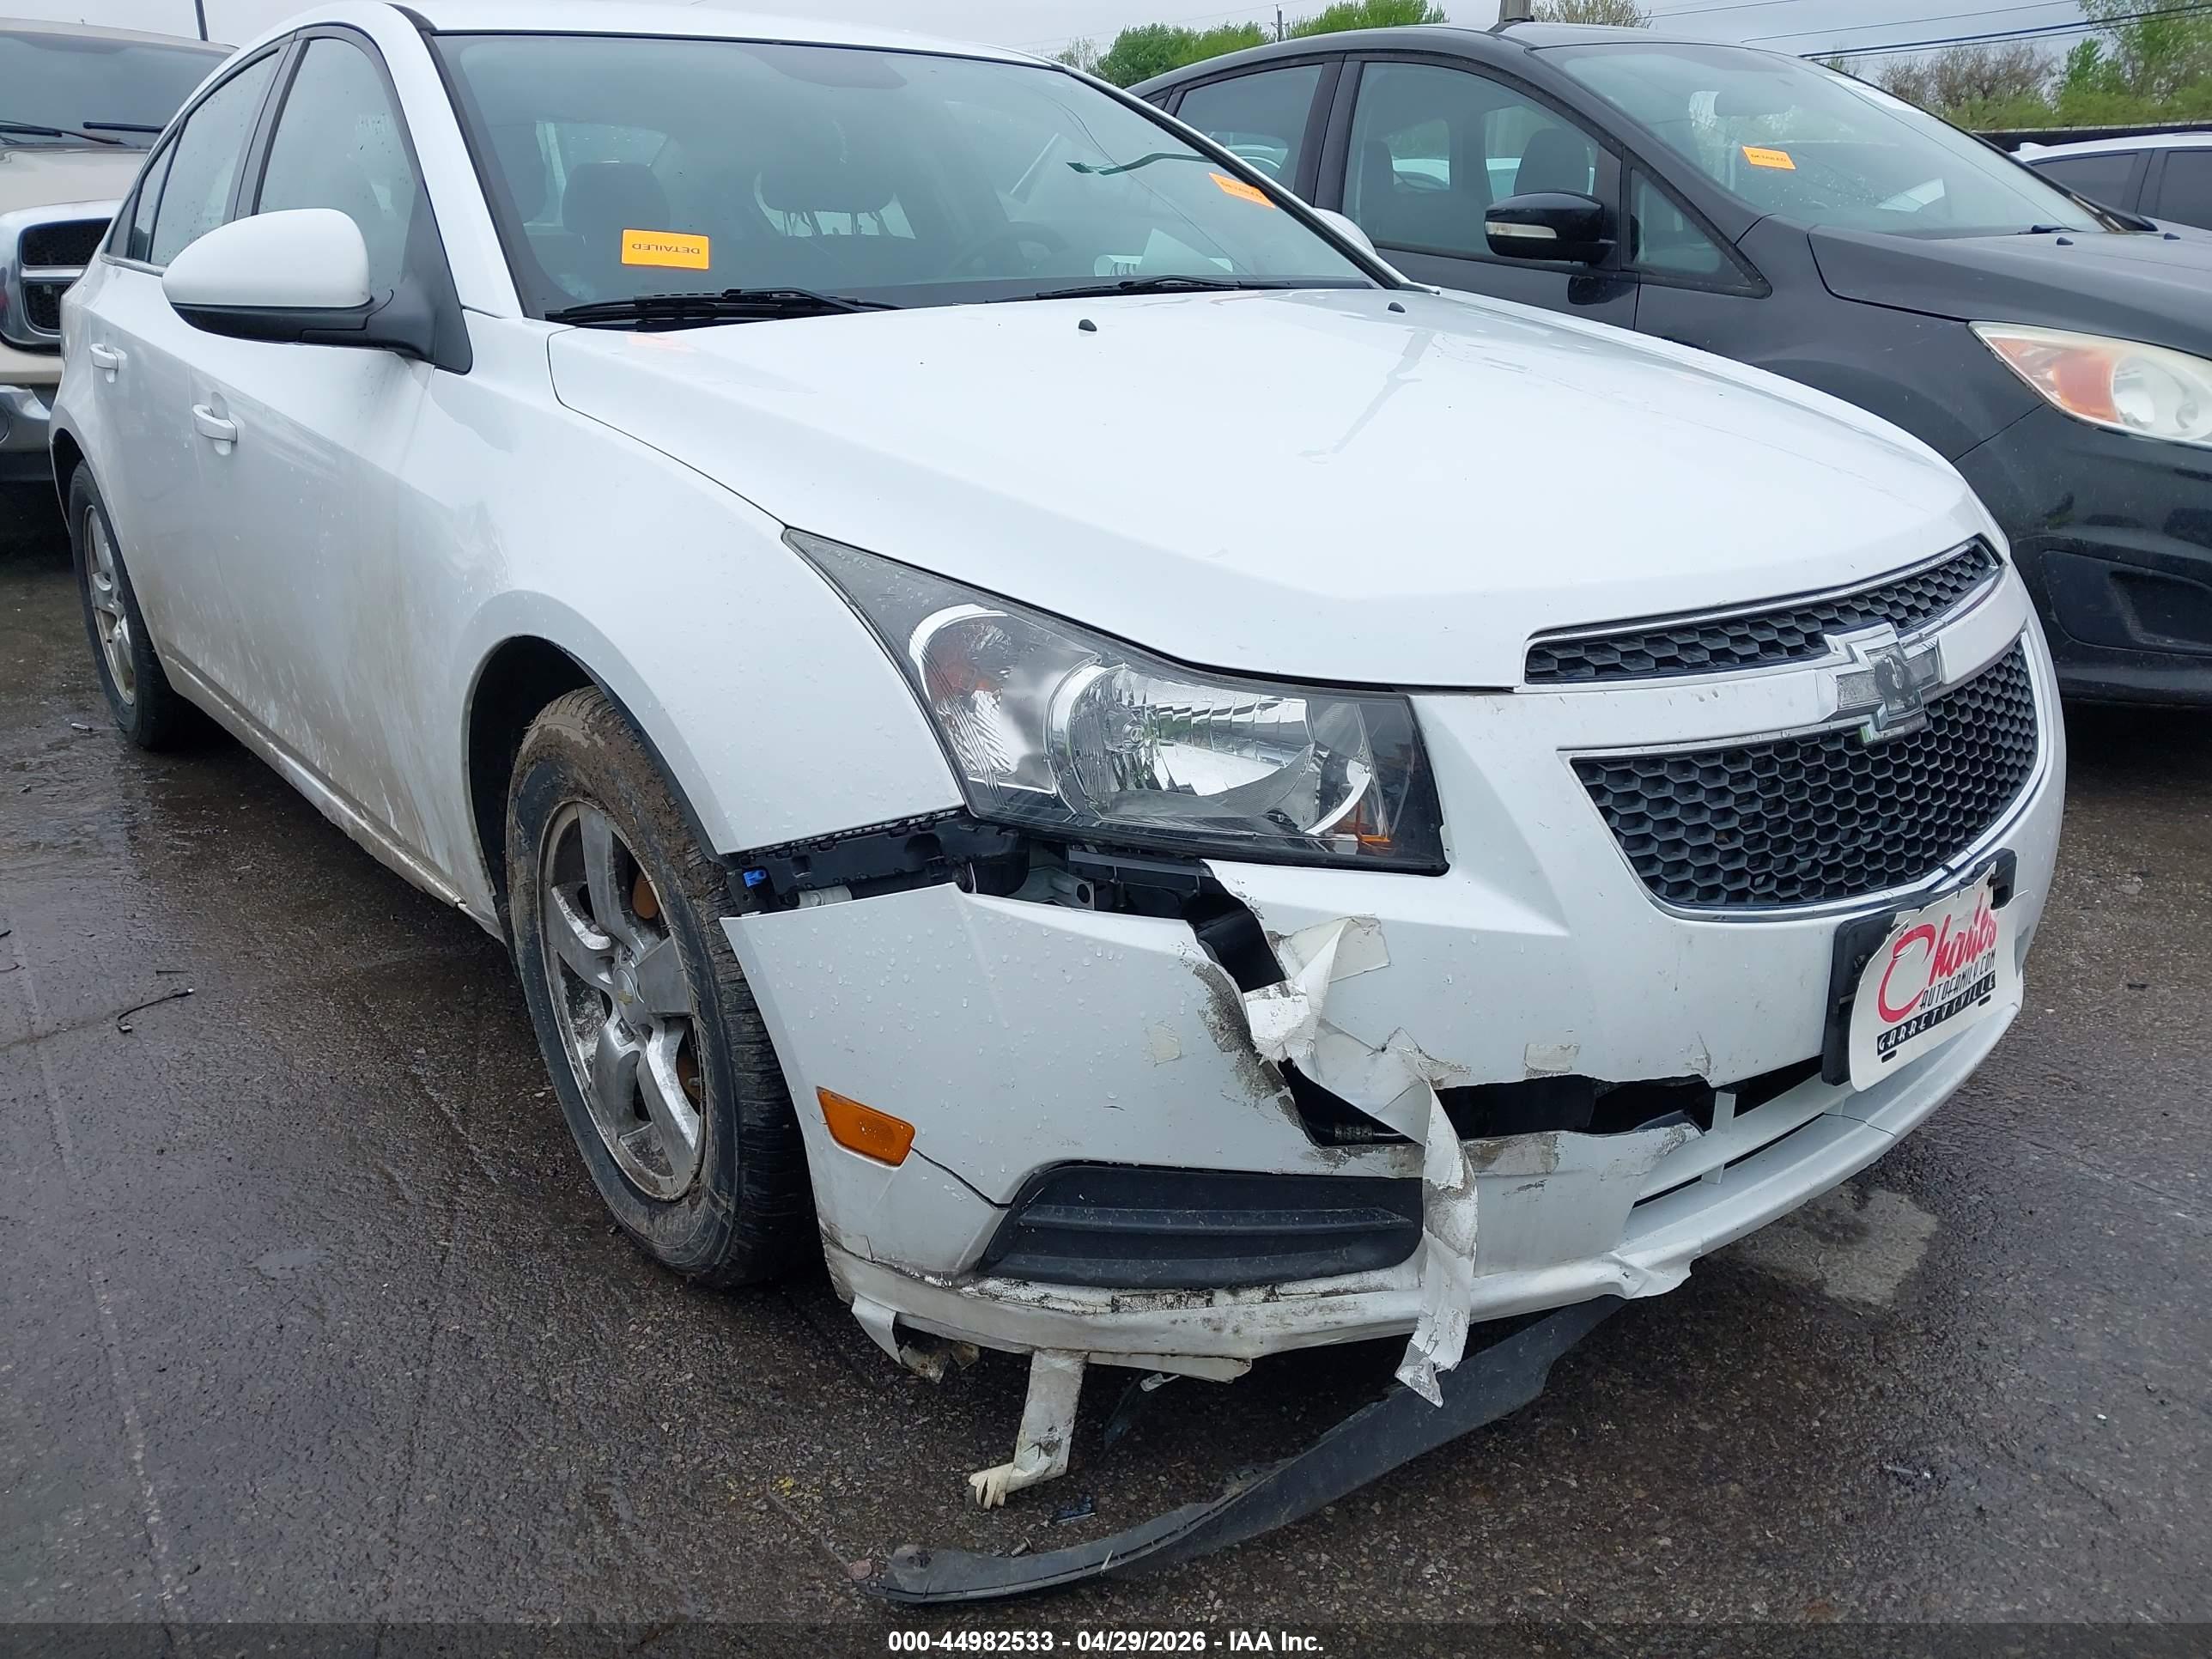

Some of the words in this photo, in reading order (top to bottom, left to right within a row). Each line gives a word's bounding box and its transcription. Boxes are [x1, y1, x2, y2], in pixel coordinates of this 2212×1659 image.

[631, 243, 701, 254] DETAILED
[1877, 891, 1998, 1024] Charles
[1918, 947, 1997, 1012] AUTOFAMILY.COM
[1877, 974, 1996, 1051] GARRETTSVILLE
